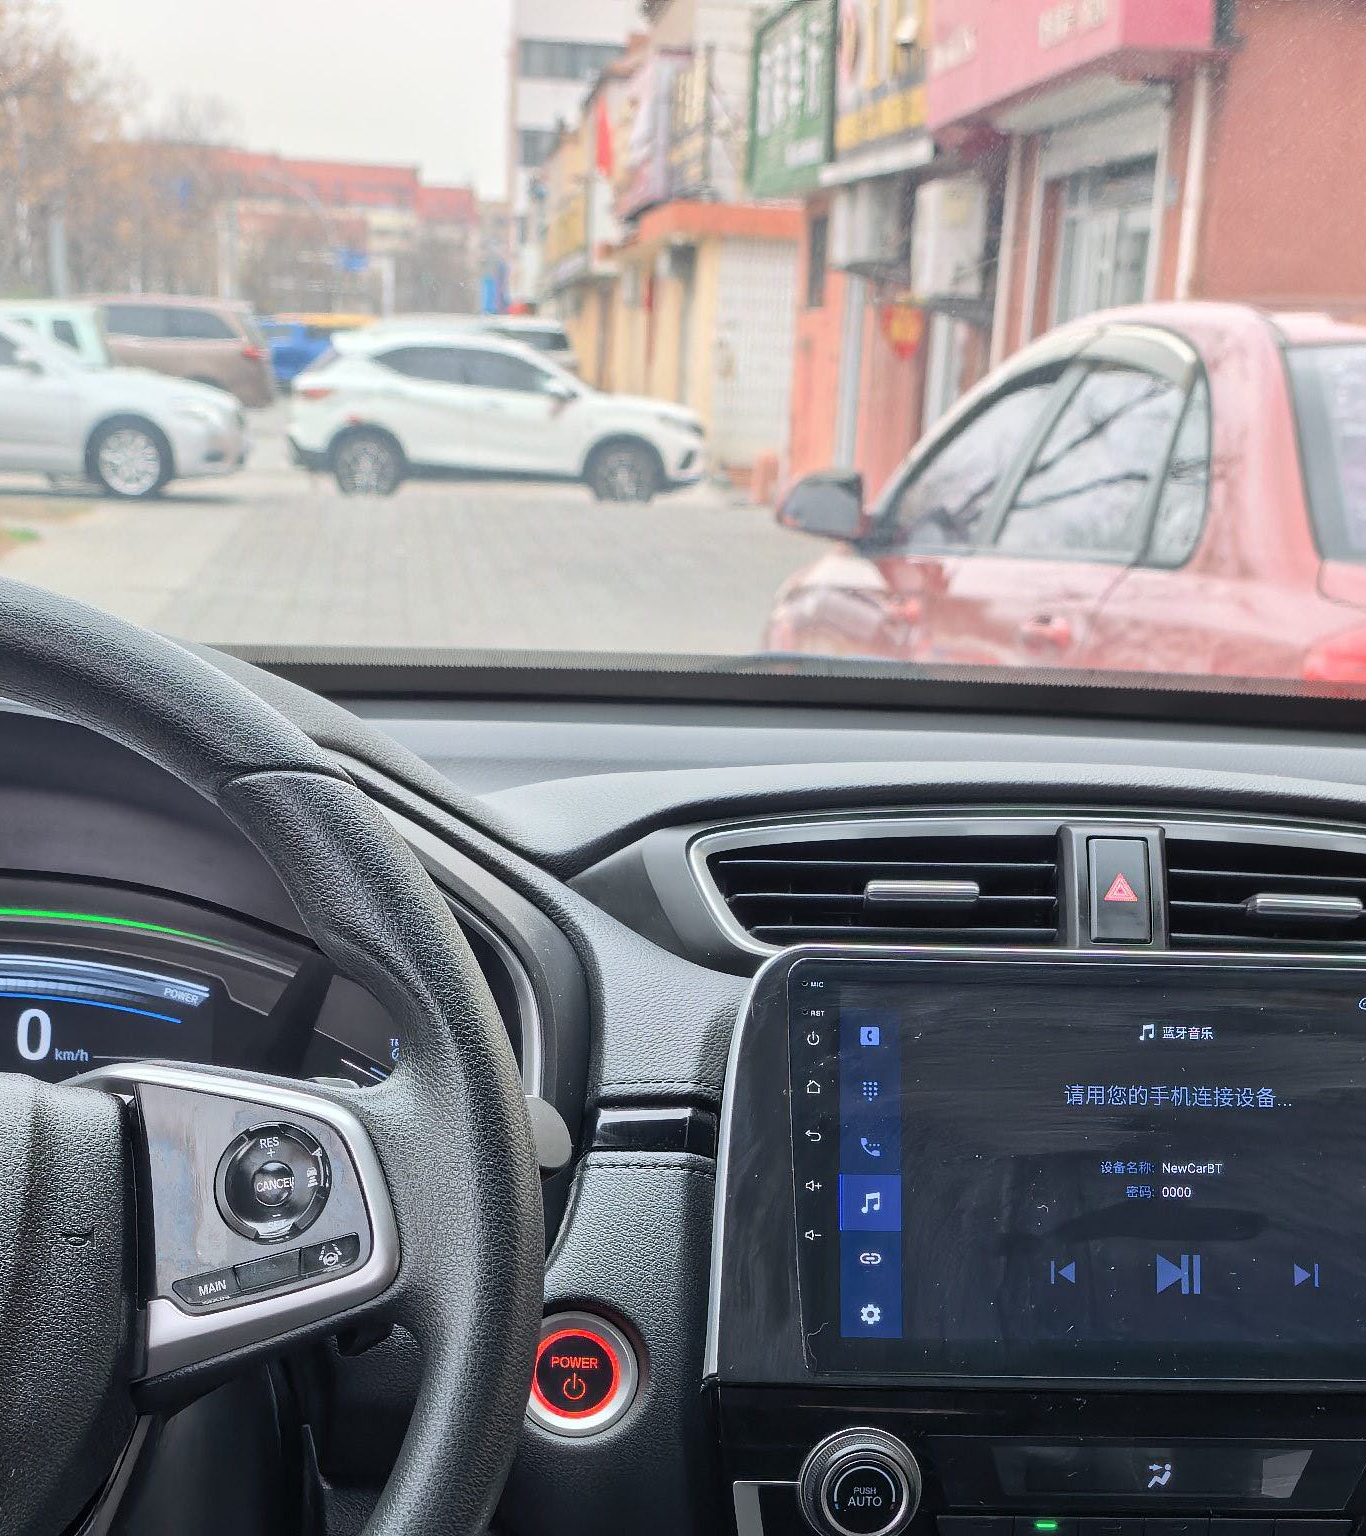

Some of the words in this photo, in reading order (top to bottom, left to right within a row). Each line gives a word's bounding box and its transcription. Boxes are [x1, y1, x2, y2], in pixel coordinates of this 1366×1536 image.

[163, 987, 199, 1005] POWER
[17, 1008, 52, 1061] 0
[54, 1048, 89, 1062] km/h
[1162, 1026, 1214, 1040] 蓝牙音乐
[259, 1137, 280, 1149] RES
[1162, 1162, 1223, 1175] NewCarBT
[1162, 1186, 1191, 1199] 0000
[198, 1279, 227, 1296] MAIN
[551, 1356, 598, 1369] POWER
[853, 1487, 877, 1495] PUSH
[848, 1496, 882, 1507] AUTO
